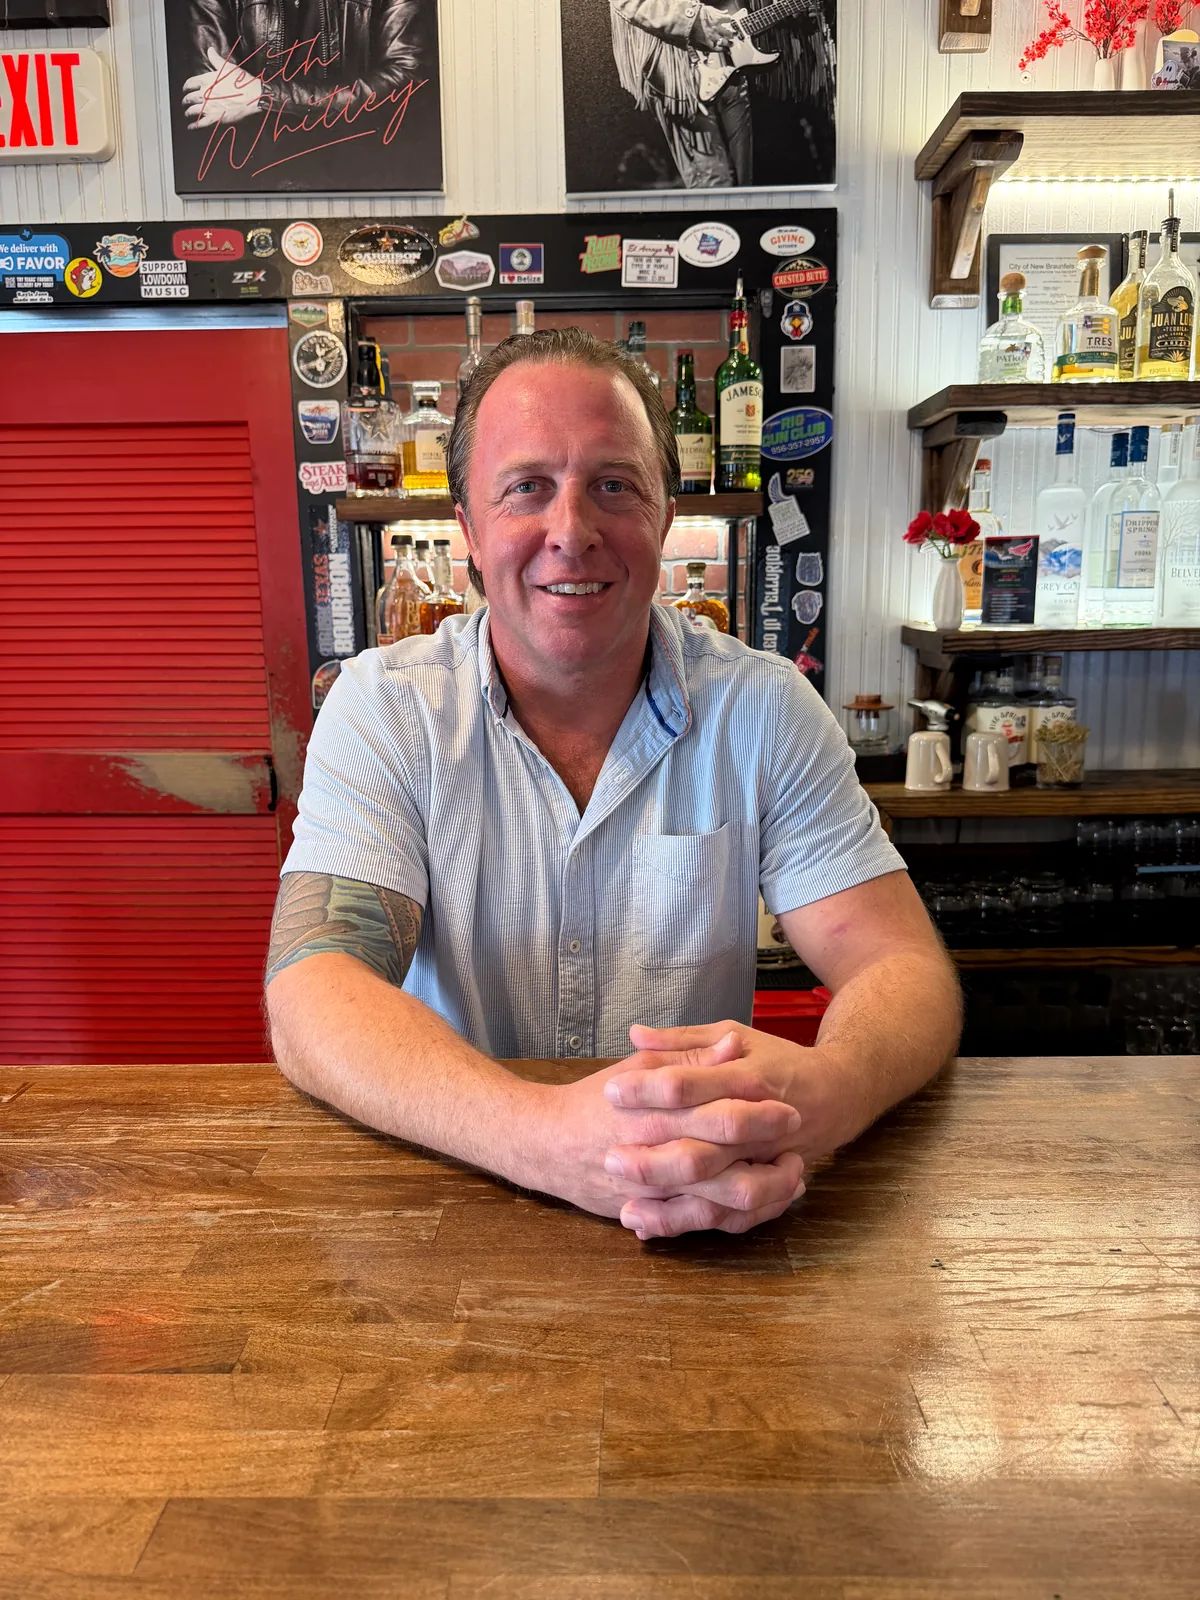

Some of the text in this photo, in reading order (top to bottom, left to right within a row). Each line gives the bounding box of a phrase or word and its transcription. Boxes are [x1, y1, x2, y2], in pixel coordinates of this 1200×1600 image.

[198, 32, 341, 128] Keith
[0, 53, 80, 147] XIT
[197, 78, 430, 181] Whitley
[770, 233, 805, 245] GIVING
[10, 243, 39, 253] deliver
[39, 243, 59, 253] with
[182, 240, 235, 251] NOLA
[17, 256, 65, 270] FAVOR
[142, 262, 185, 272] SUPPORT
[1008, 263, 1021, 271] City
[142, 273, 187, 285] LOWDOWN
[517, 275, 541, 283] Belize
[774, 269, 828, 286] CRESTED BUTTE
[143, 287, 187, 297] MUSIC
[1151, 312, 1194, 328] JUAN LOB
[1086, 337, 1113, 347] TRES
[790, 420, 826, 441] CLUB
[301, 464, 346, 480] STEAK
[320, 475, 345, 487] ALE
[1126, 526, 1158, 534] SPRING
[1171, 567, 1200, 578] BELVE
[328, 553, 354, 653] BOURBON
